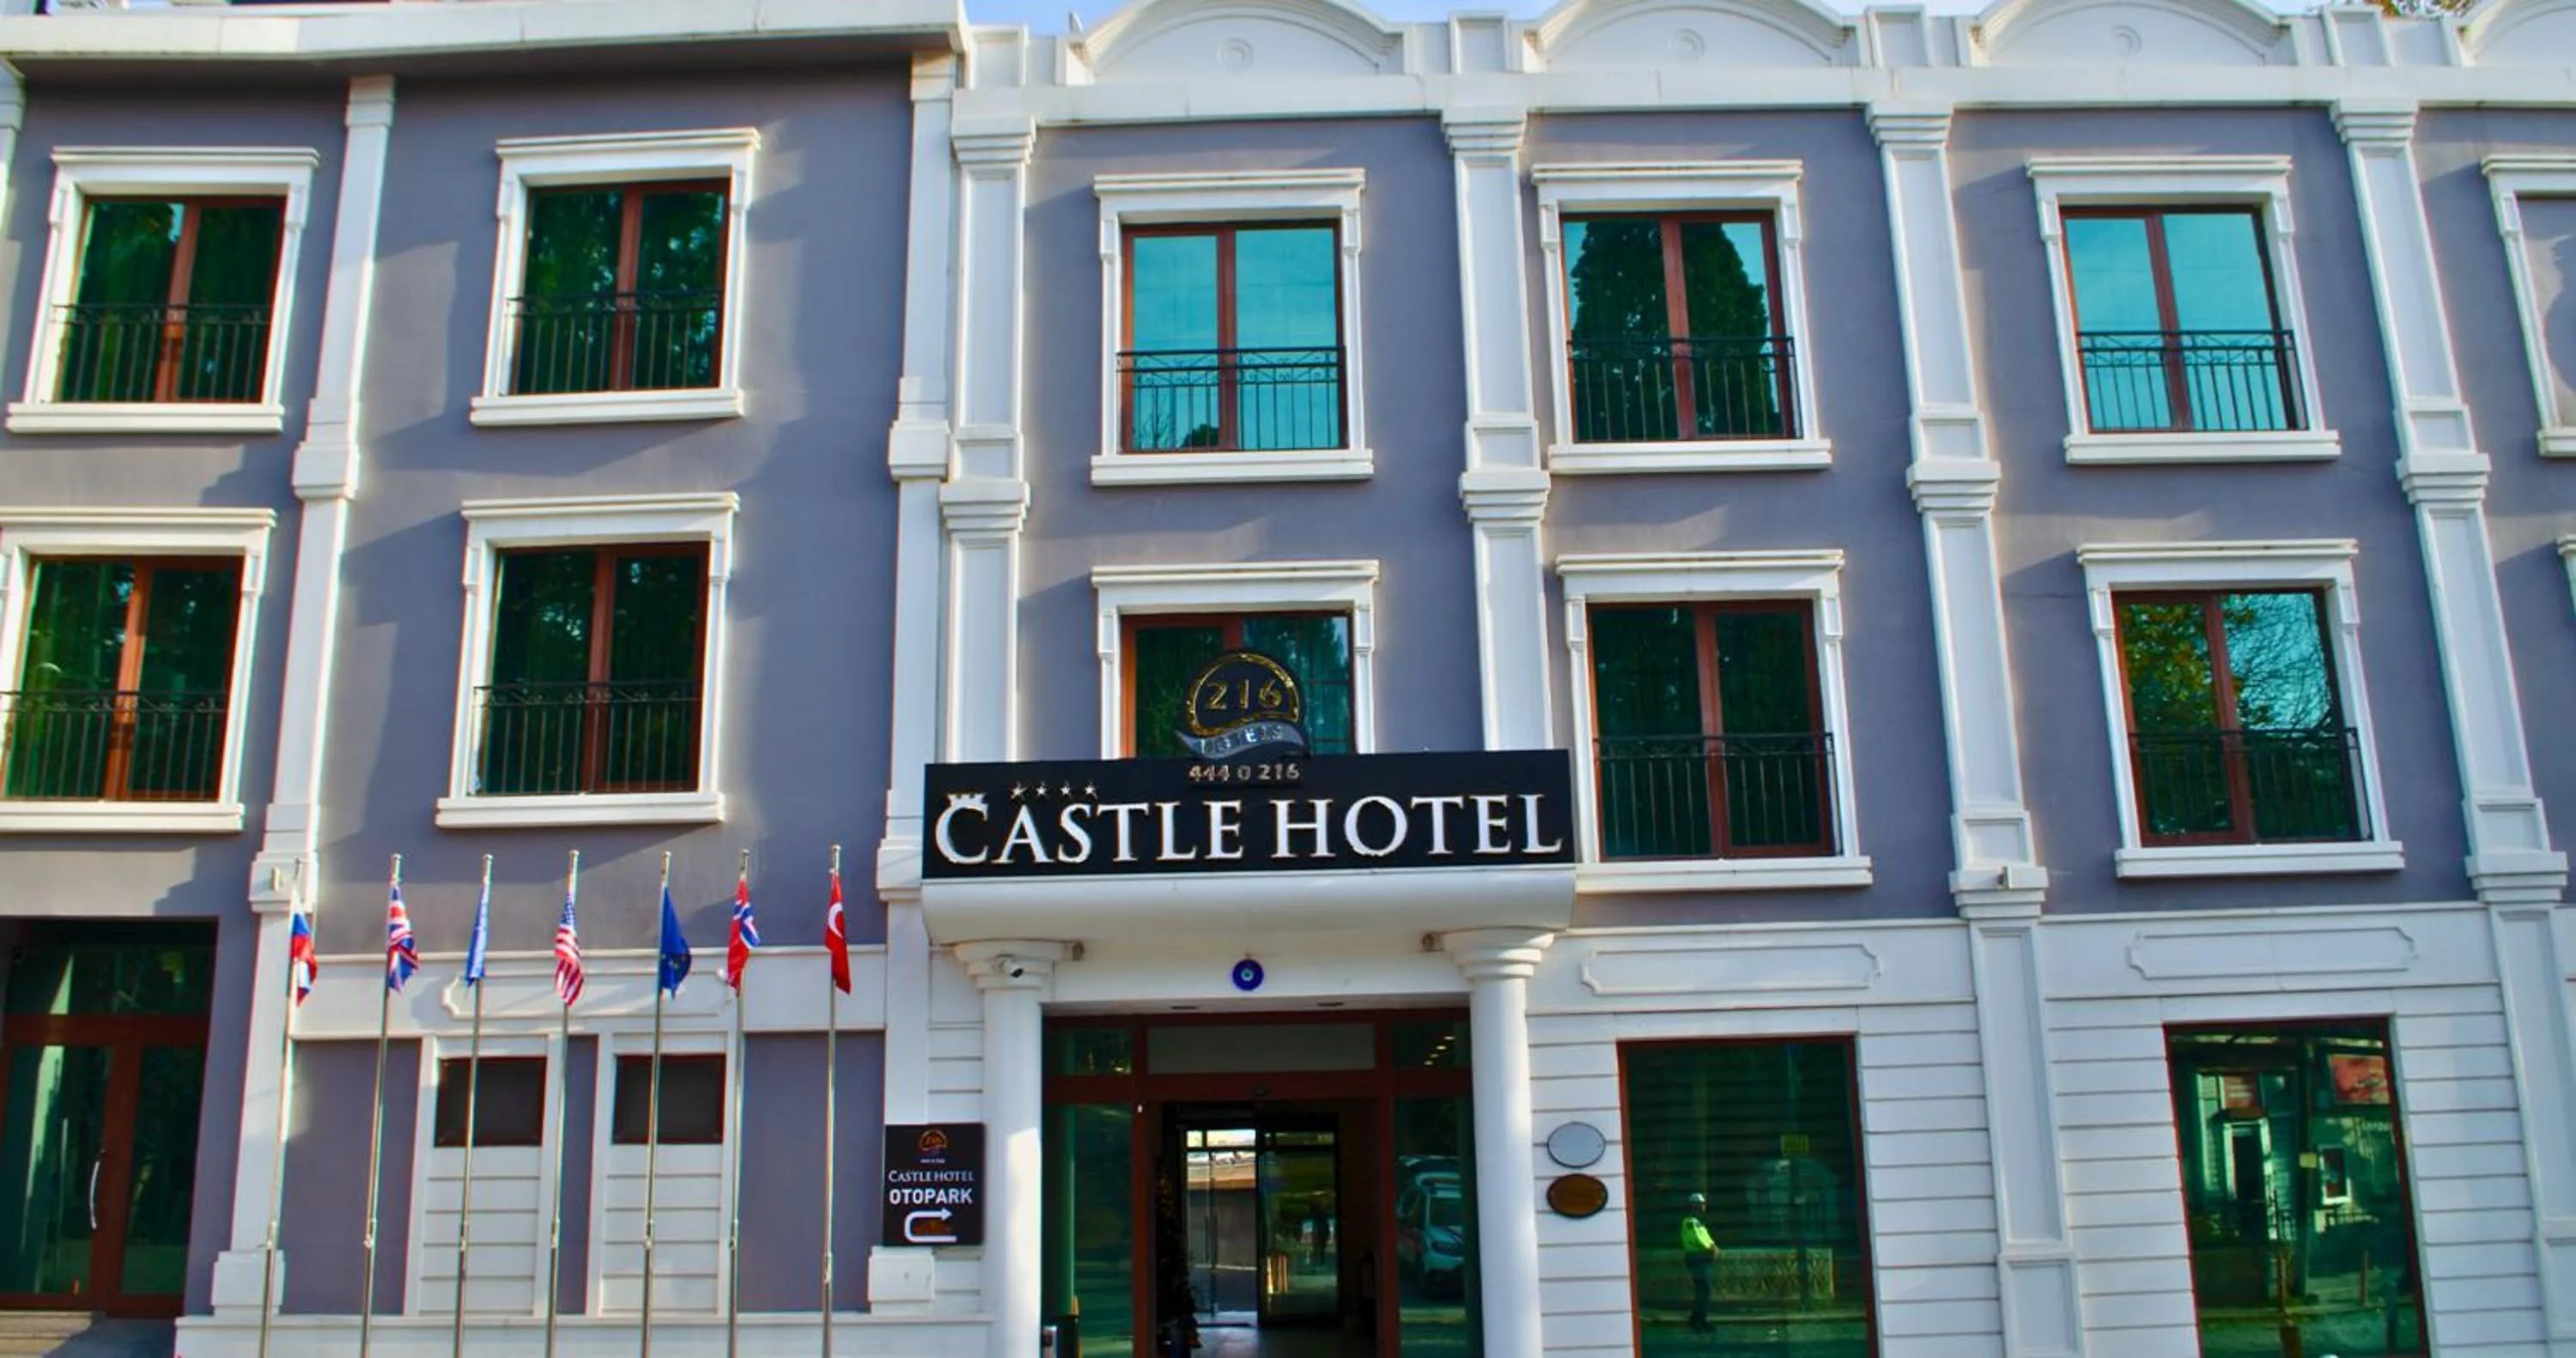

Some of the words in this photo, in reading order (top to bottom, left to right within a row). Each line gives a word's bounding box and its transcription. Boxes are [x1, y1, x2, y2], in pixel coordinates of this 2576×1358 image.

[1204, 679, 1283, 710] 216
[1188, 764, 1231, 782] 444
[1236, 766, 1252, 781] 0
[1258, 763, 1300, 781] 216
[934, 797, 1244, 864] CASTLE
[1269, 794, 1563, 858] HOTEL
[889, 1170, 932, 1182] CASTLE
[933, 1170, 975, 1182] HOTEL
[889, 1188, 973, 1203] OTOPARK
